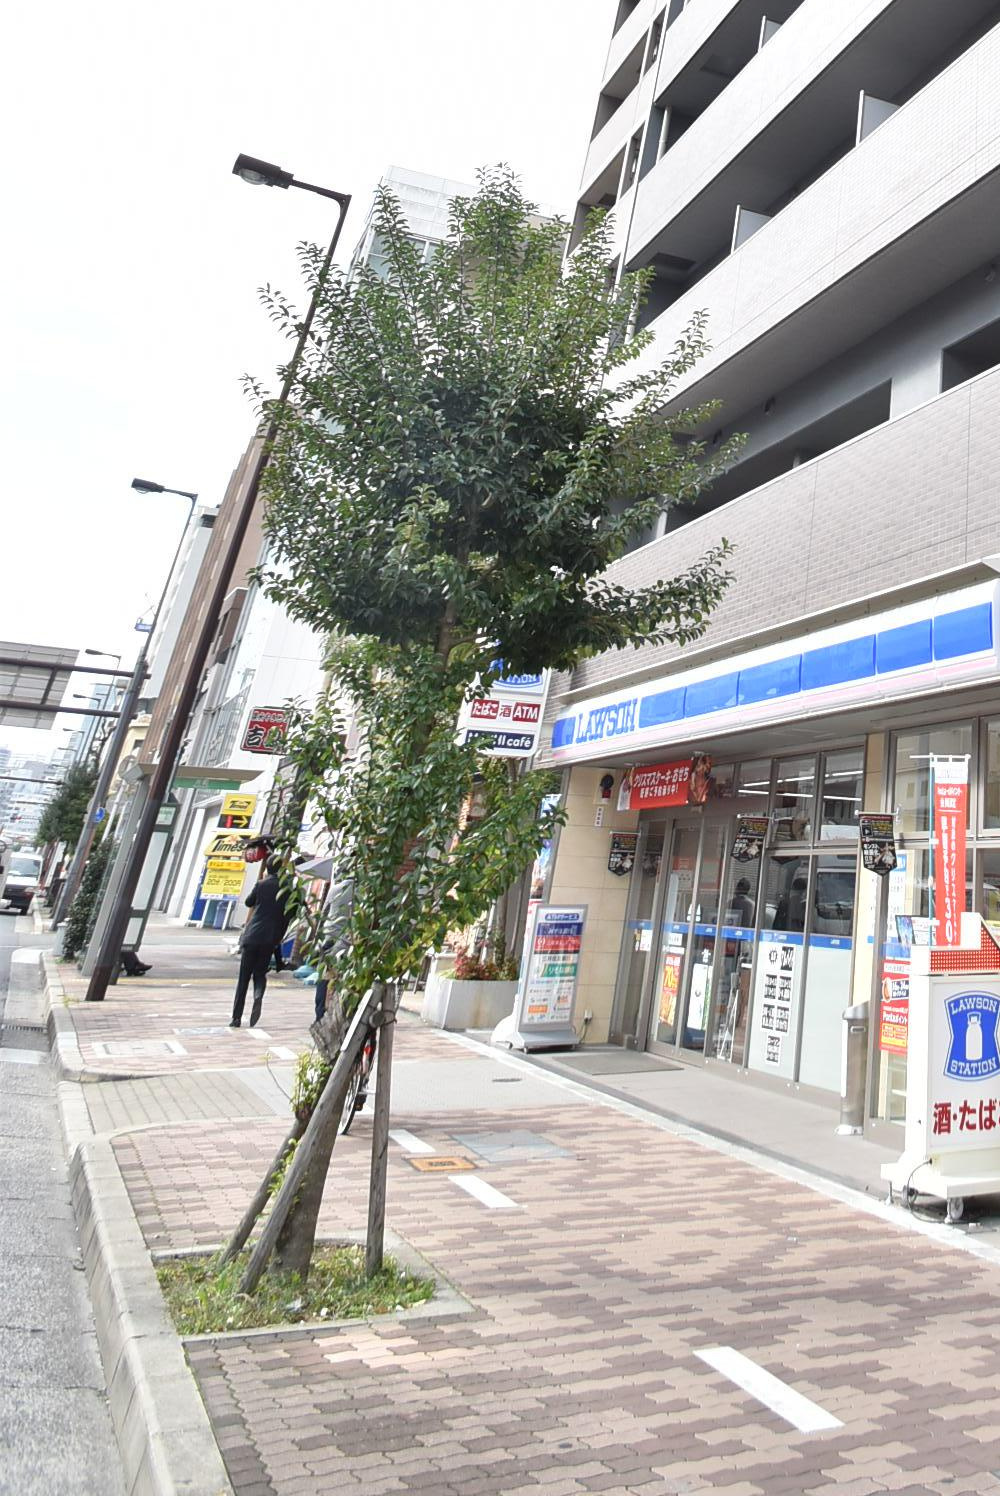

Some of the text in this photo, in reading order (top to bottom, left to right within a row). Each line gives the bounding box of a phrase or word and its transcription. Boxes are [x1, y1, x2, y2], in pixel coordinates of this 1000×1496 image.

[472, 699, 498, 716] たばこ
[513, 705, 539, 720] ATM
[575, 697, 638, 744] LAWSON
[507, 736, 532, 748] café
[212, 838, 245, 853] Times
[950, 997, 998, 1015] LAWSON
[950, 1057, 997, 1075] STATION
